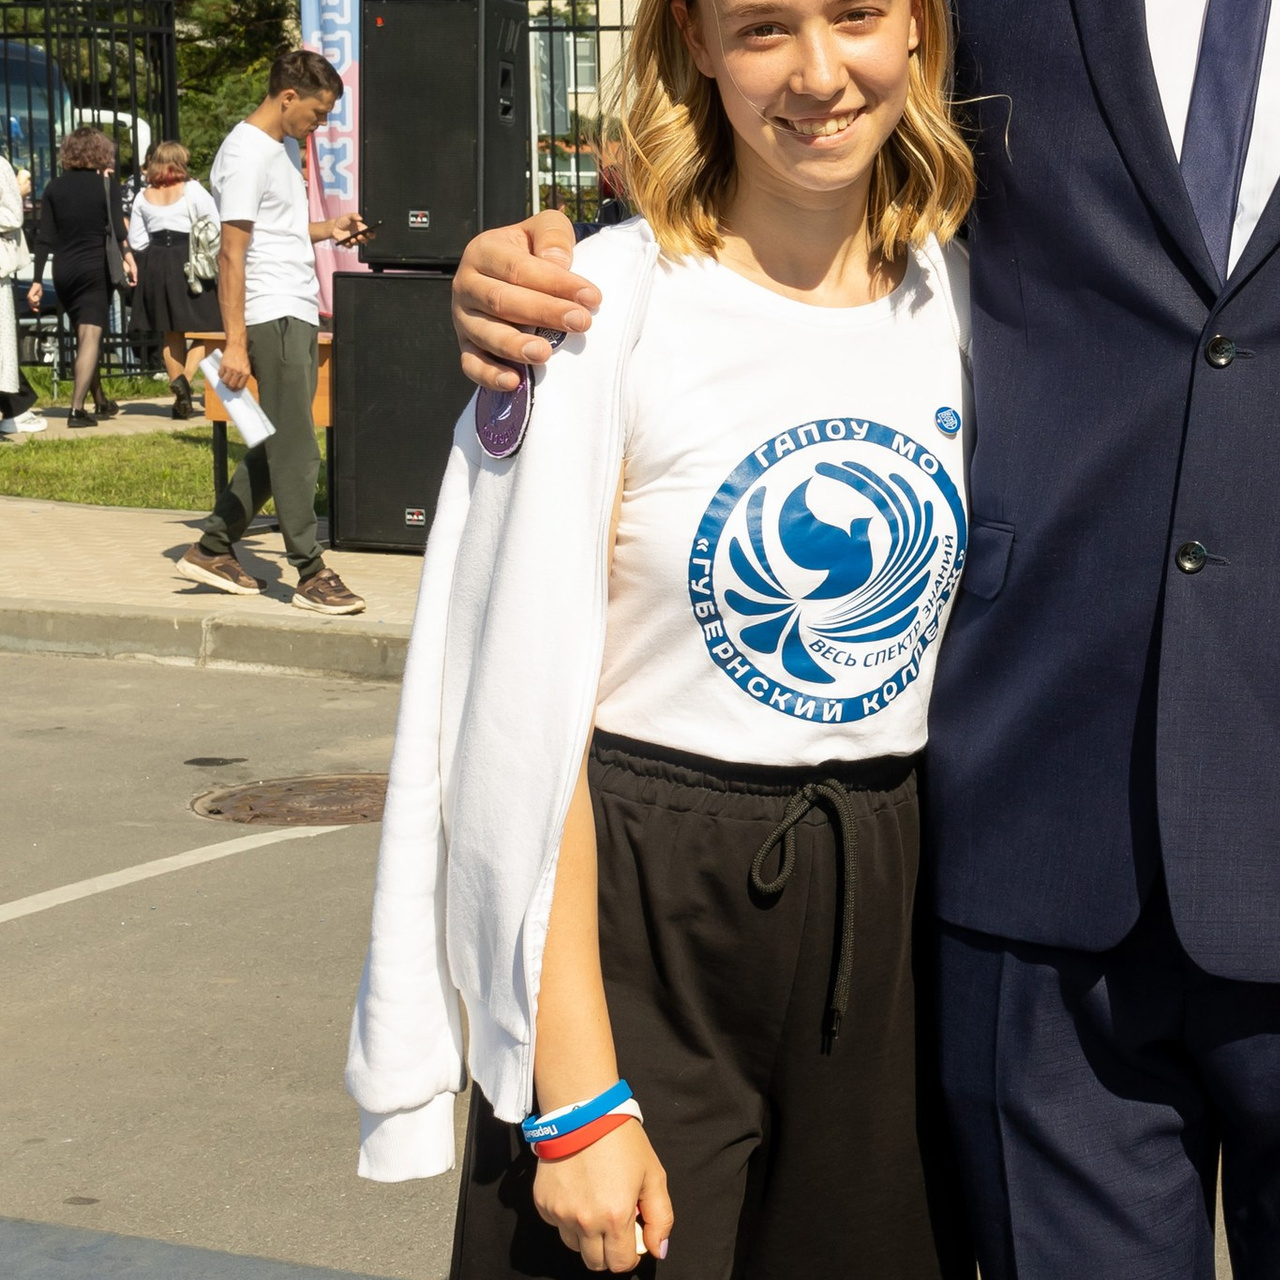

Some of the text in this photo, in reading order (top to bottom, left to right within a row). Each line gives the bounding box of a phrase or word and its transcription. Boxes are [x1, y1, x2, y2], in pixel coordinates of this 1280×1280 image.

[754, 420, 940, 475] ГАПОУ МО
[808, 534, 954, 668] ВЕСЬ СПЕКТР ЗНАНИЙ
